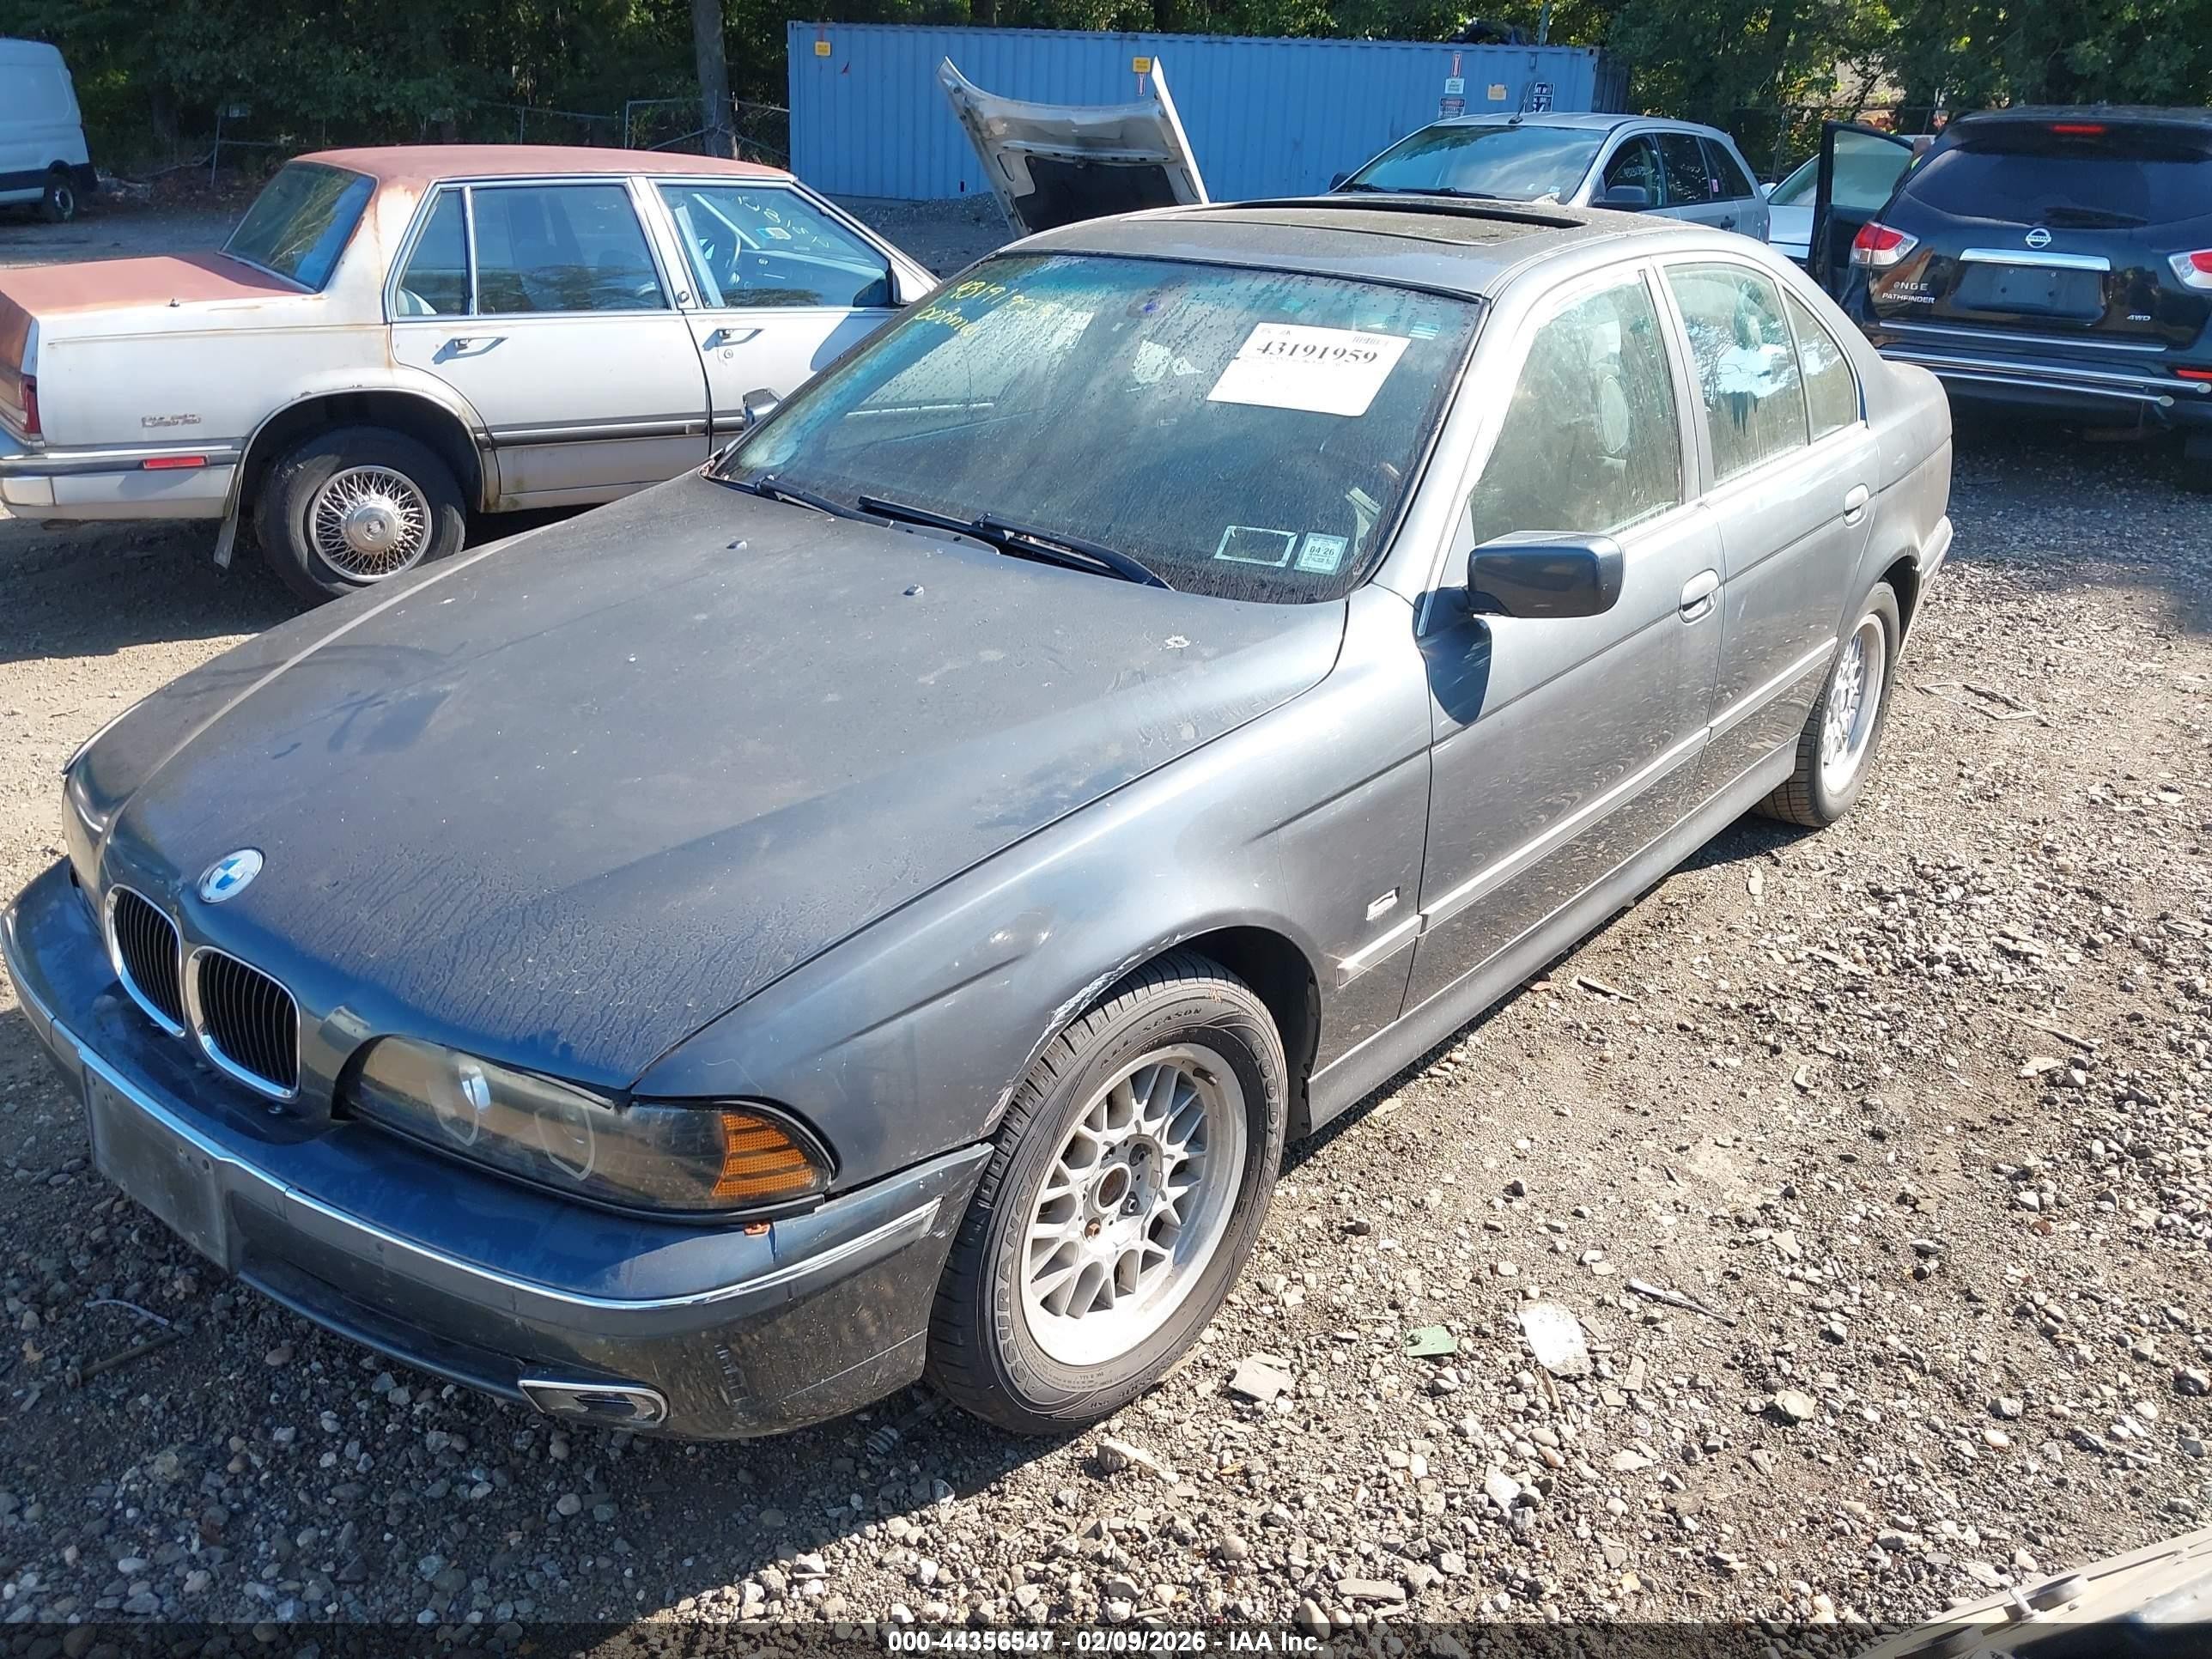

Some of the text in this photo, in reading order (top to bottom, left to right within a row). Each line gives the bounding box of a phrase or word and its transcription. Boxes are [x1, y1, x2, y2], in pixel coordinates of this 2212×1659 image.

[1256, 339, 1378, 365] 43191959
[1881, 292, 1935, 304] PATHFINDER
[1240, 1038, 1279, 1251] GOODYEAR
[996, 1151, 1046, 1400] ASSURANCE
